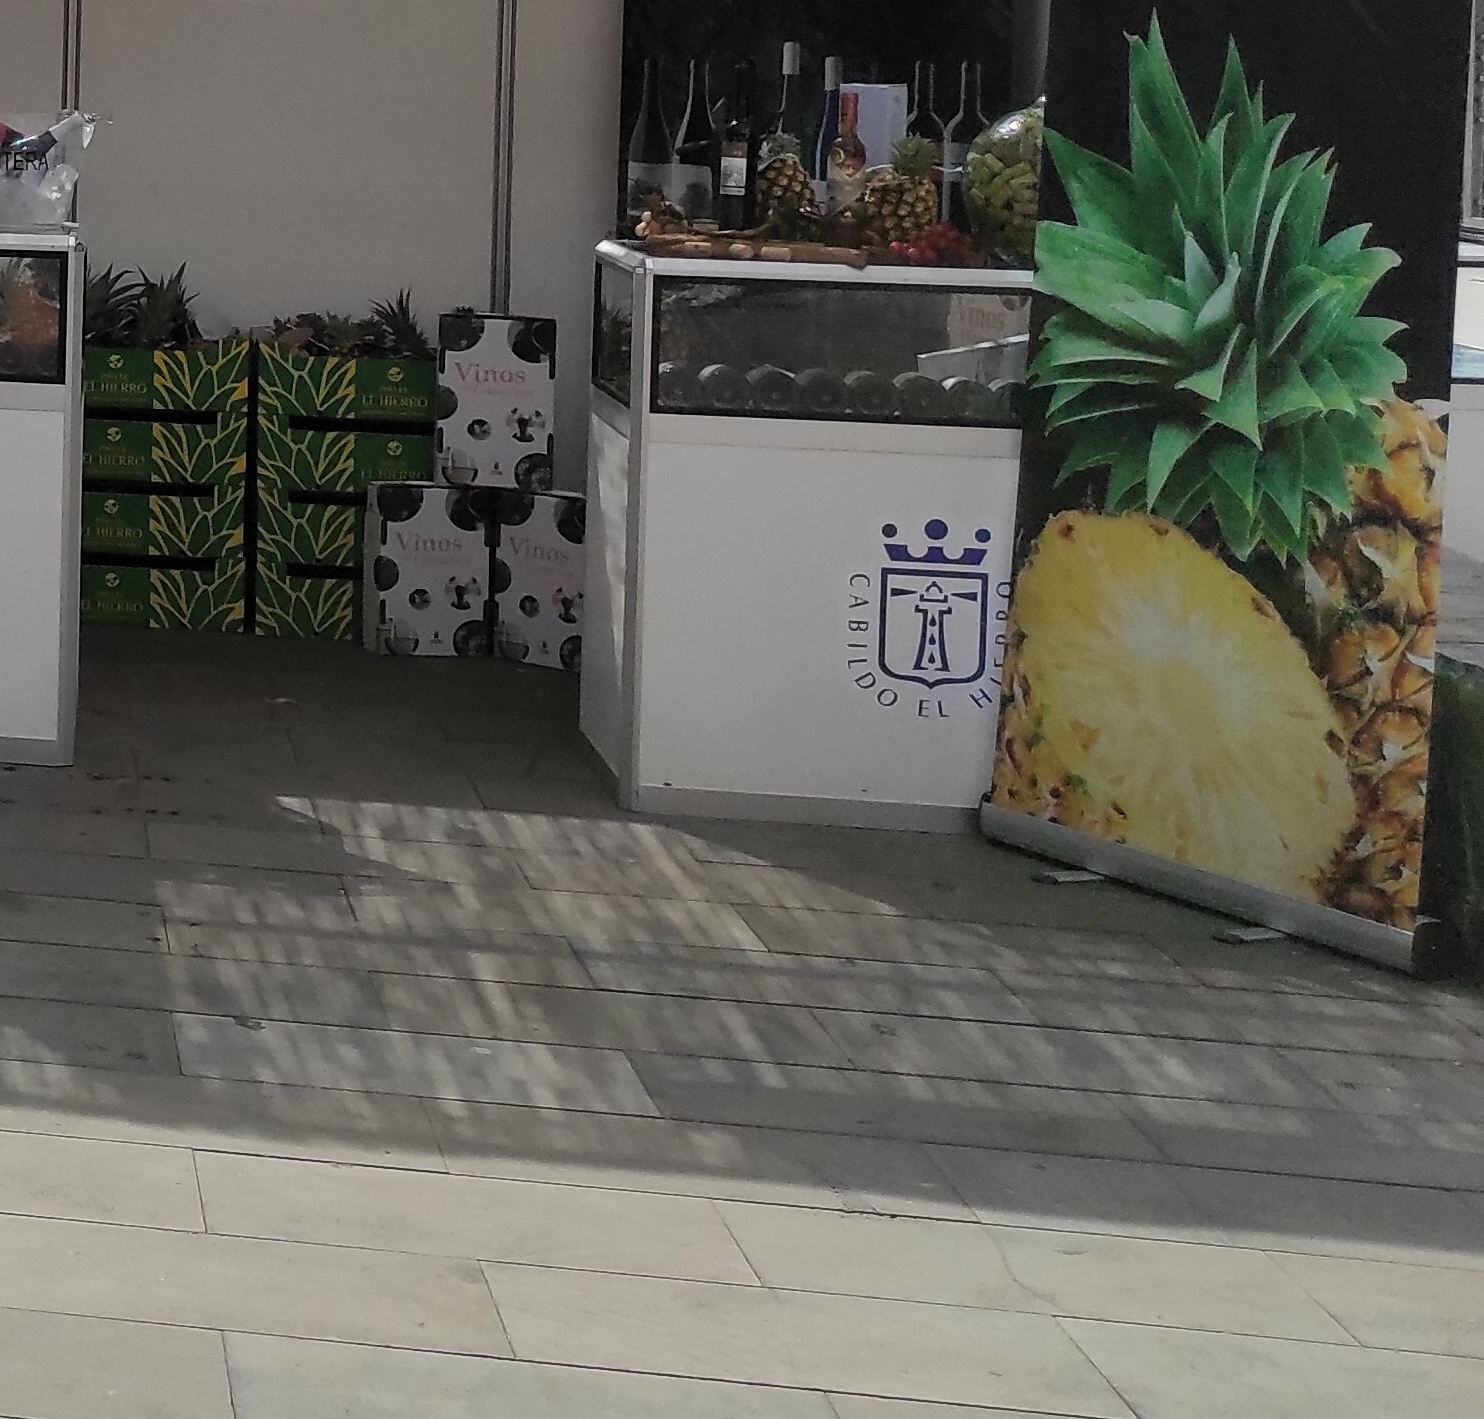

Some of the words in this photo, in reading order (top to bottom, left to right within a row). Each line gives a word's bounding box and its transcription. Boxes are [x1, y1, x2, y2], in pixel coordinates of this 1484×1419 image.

[454, 361, 527, 384] Vinos
[396, 532, 462, 553] Vinos
[509, 535, 569, 563] Vinos
[846, 573, 899, 707] CABILDO
[917, 699, 950, 718] EL
